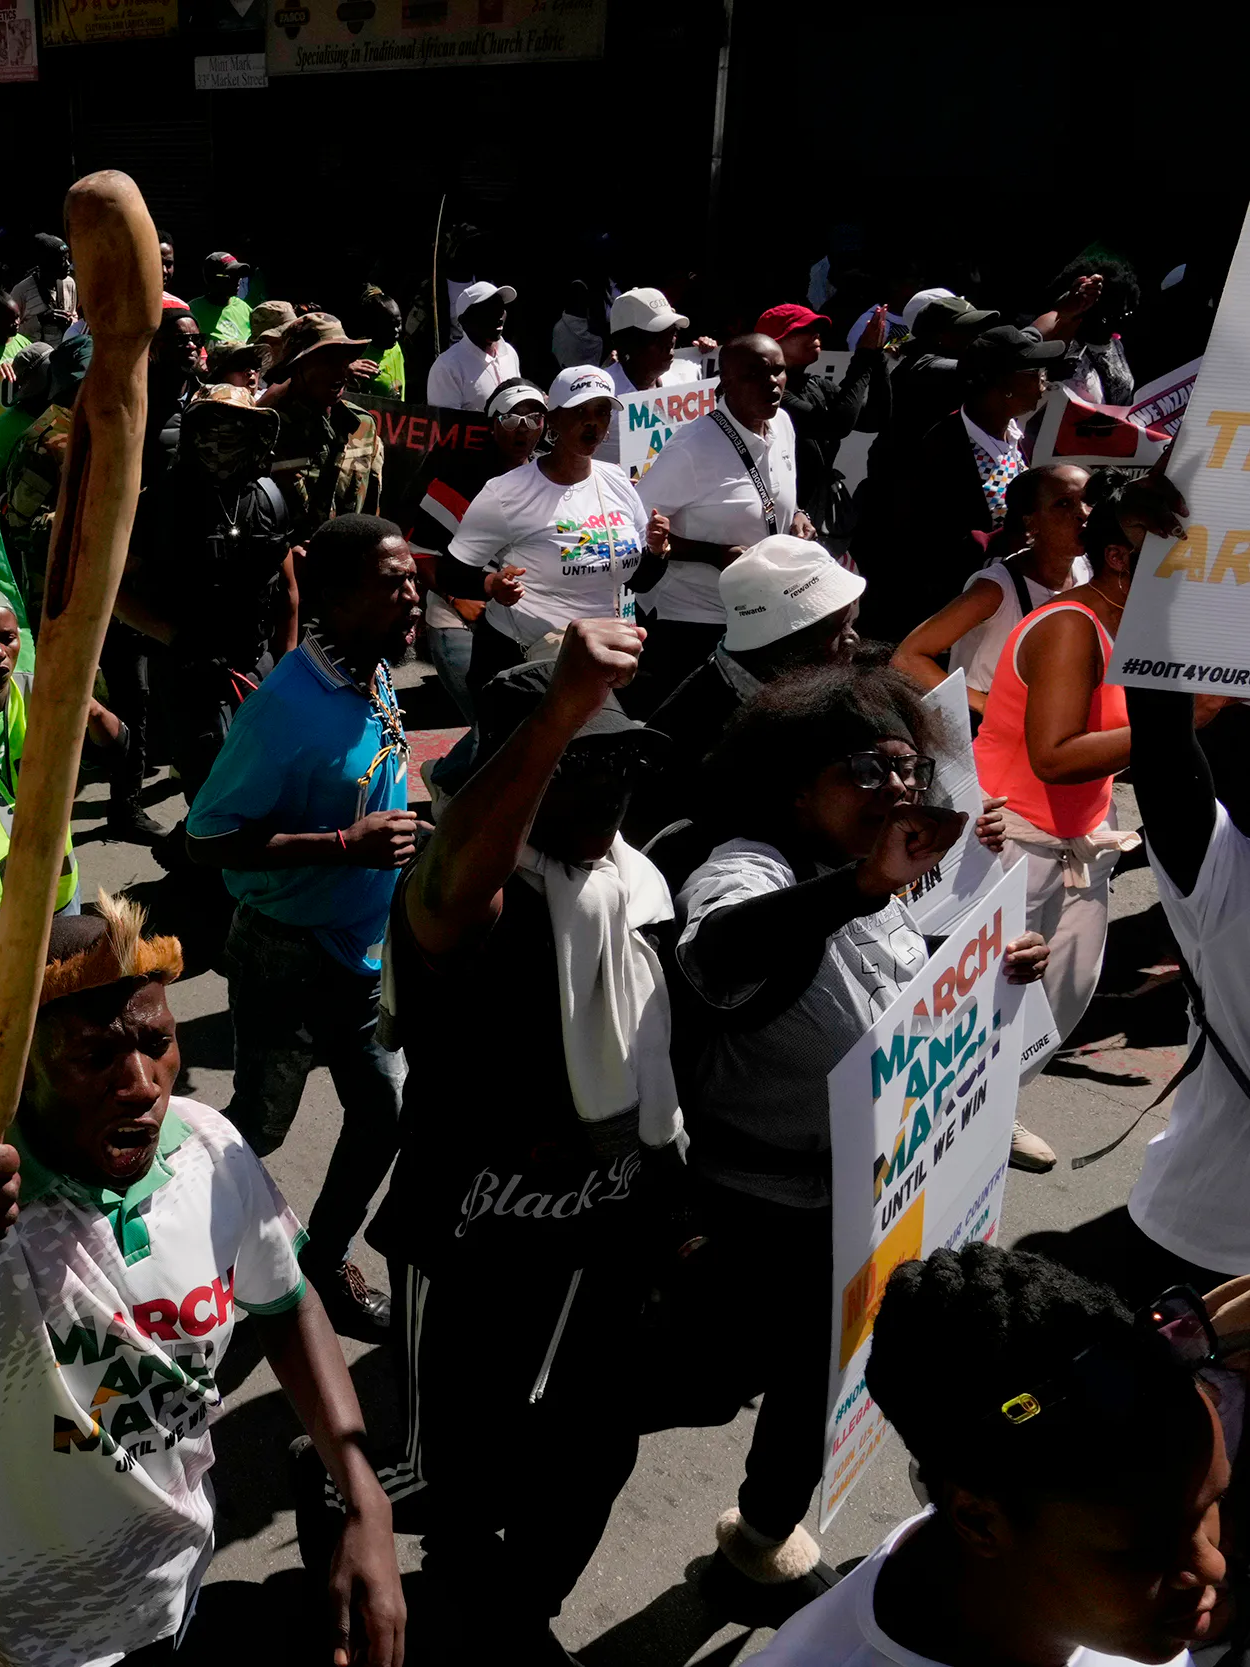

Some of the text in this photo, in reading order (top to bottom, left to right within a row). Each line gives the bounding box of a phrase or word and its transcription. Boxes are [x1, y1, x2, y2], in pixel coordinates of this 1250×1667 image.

[296, 28, 565, 72] Specialising in Traditional African and Church Fabric
[211, 73, 241, 87] Market
[241, 71, 268, 86] Street
[570, 381, 591, 391] CAPE
[628, 387, 715, 433] MARCH
[556, 511, 625, 534] MARCH
[577, 529, 620, 546] AND
[562, 565, 597, 576] UNTIL
[622, 556, 640, 570] WIN
[790, 575, 820, 599] rewards
[739, 605, 767, 617] rewards
[1122, 658, 1250, 686] #DOIT4YOUR
[871, 906, 1002, 1105] MARCH
[899, 996, 978, 1124] AND
[873, 1008, 1001, 1207] MARCH
[881, 1160, 927, 1232] UNTIL
[933, 1120, 956, 1167] WE
[961, 1079, 988, 1132] WIN
[454, 1164, 603, 1239] Black
[965, 1157, 1008, 1226] COUNTRY
[47, 1264, 235, 1366] MARCH
[52, 1375, 222, 1456] MARC
[115, 1439, 157, 1475] UNTIL
[163, 1423, 186, 1450] WE
